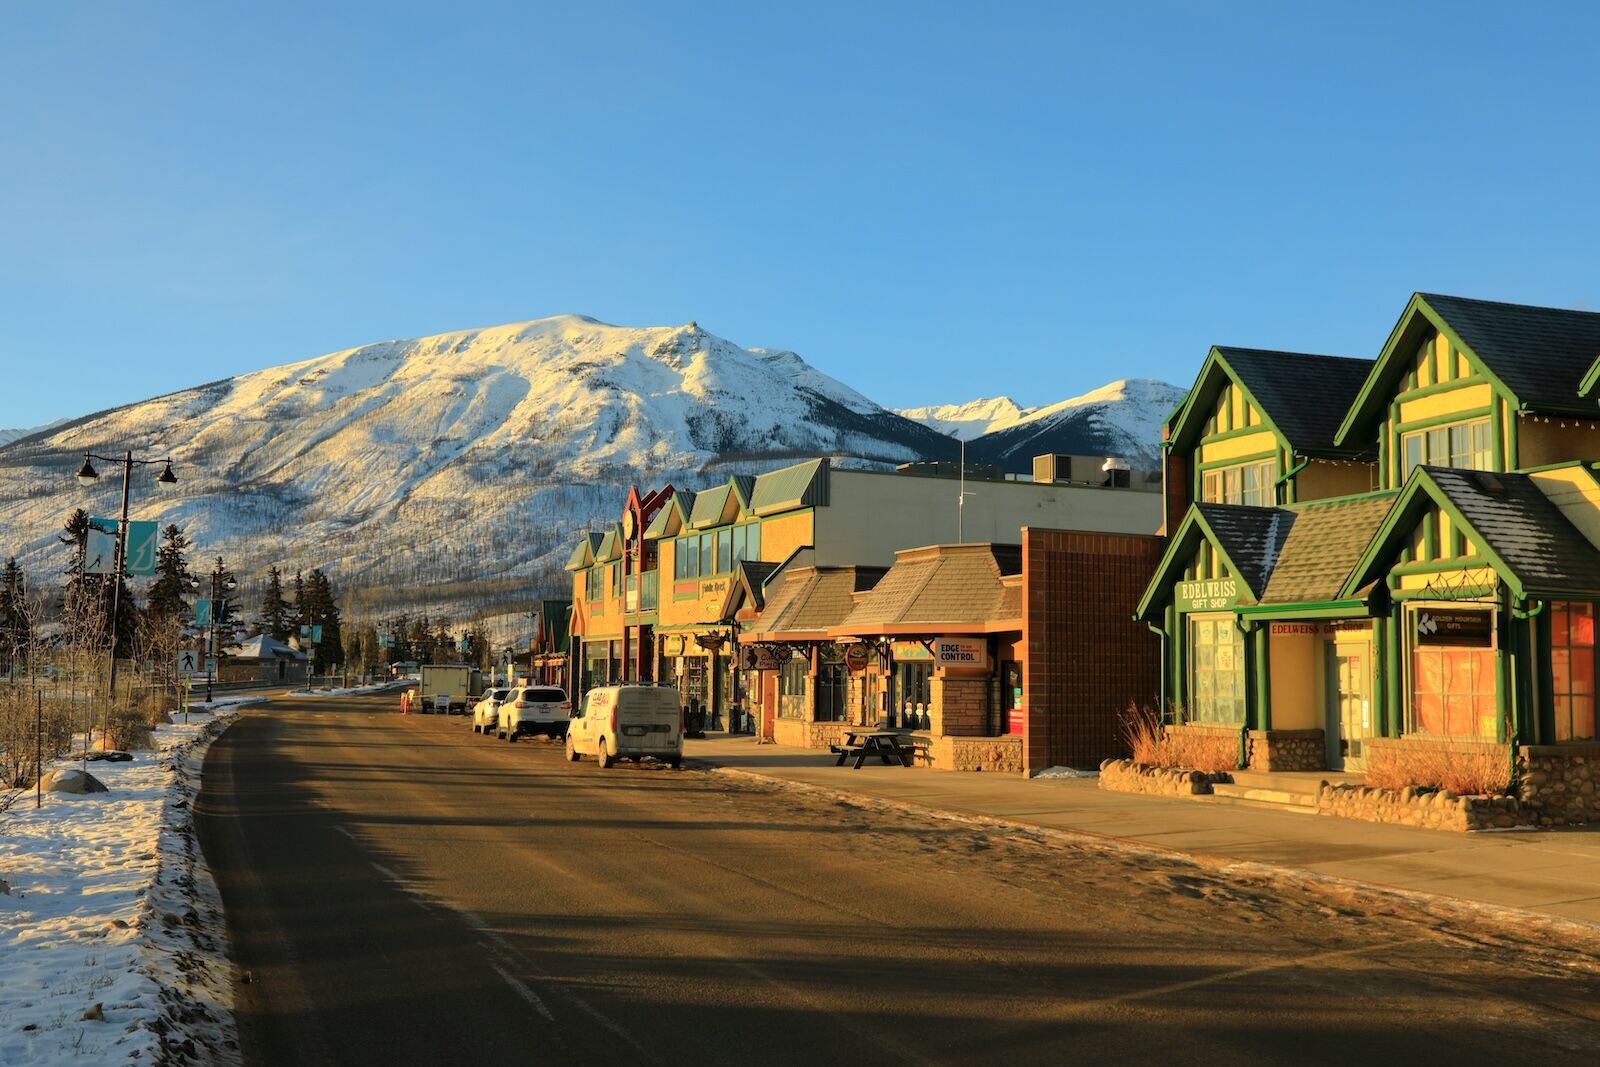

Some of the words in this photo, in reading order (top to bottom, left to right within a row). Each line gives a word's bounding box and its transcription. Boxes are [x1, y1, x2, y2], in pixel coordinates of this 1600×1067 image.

[1182, 581, 1236, 599] EDELWEISS
[1192, 599, 1207, 609] GIFT
[1210, 598, 1227, 608] SHOP
[1272, 624, 1319, 634] EDELWEISS
[1343, 623, 1364, 632] SHOP
[941, 644, 959, 652] EDGE
